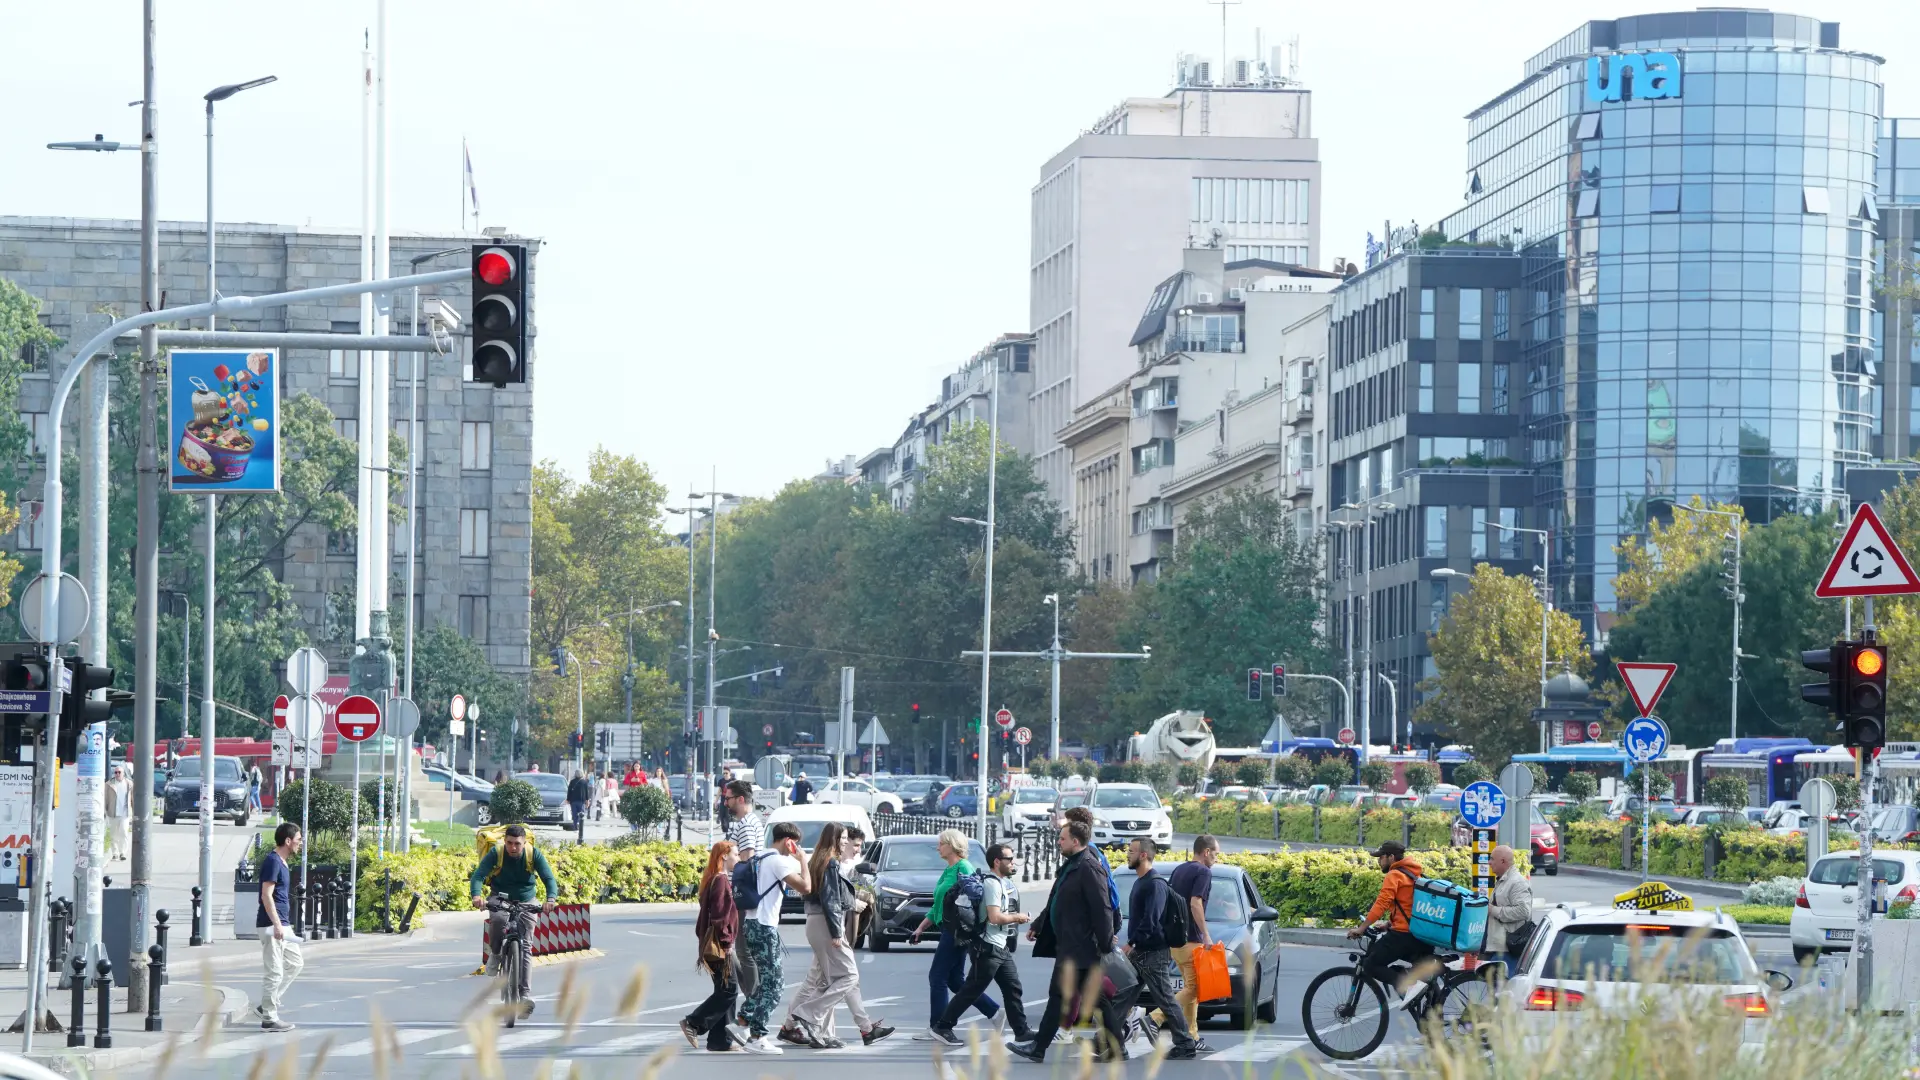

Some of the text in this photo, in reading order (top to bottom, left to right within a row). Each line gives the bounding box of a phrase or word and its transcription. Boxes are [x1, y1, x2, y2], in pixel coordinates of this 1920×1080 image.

[1587, 52, 1680, 102] una
[1638, 884, 1660, 897] TAXI
[1416, 900, 1447, 919] Wolt
[1675, 900, 1690, 909] 112
